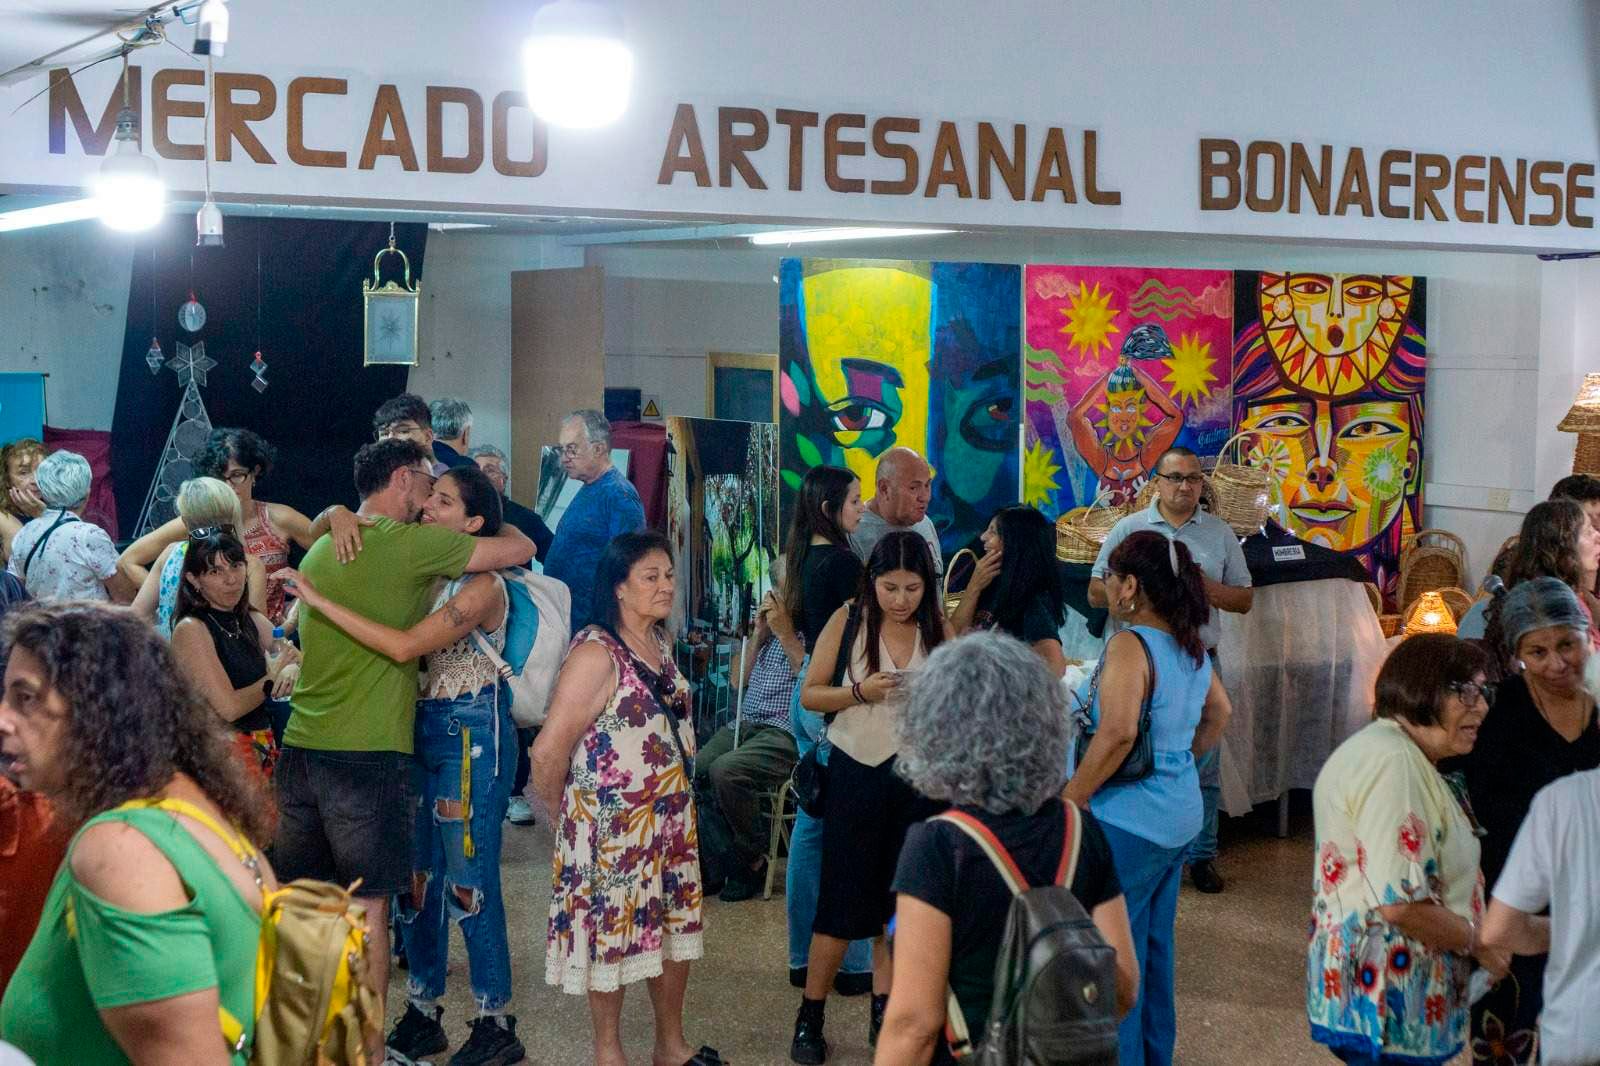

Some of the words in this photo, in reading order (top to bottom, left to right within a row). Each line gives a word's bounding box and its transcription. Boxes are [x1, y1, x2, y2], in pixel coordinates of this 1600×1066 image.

[49, 66, 548, 178] MERCADO
[657, 103, 1121, 206] ARTESANAL
[1199, 138, 1595, 229] BONAERENSE
